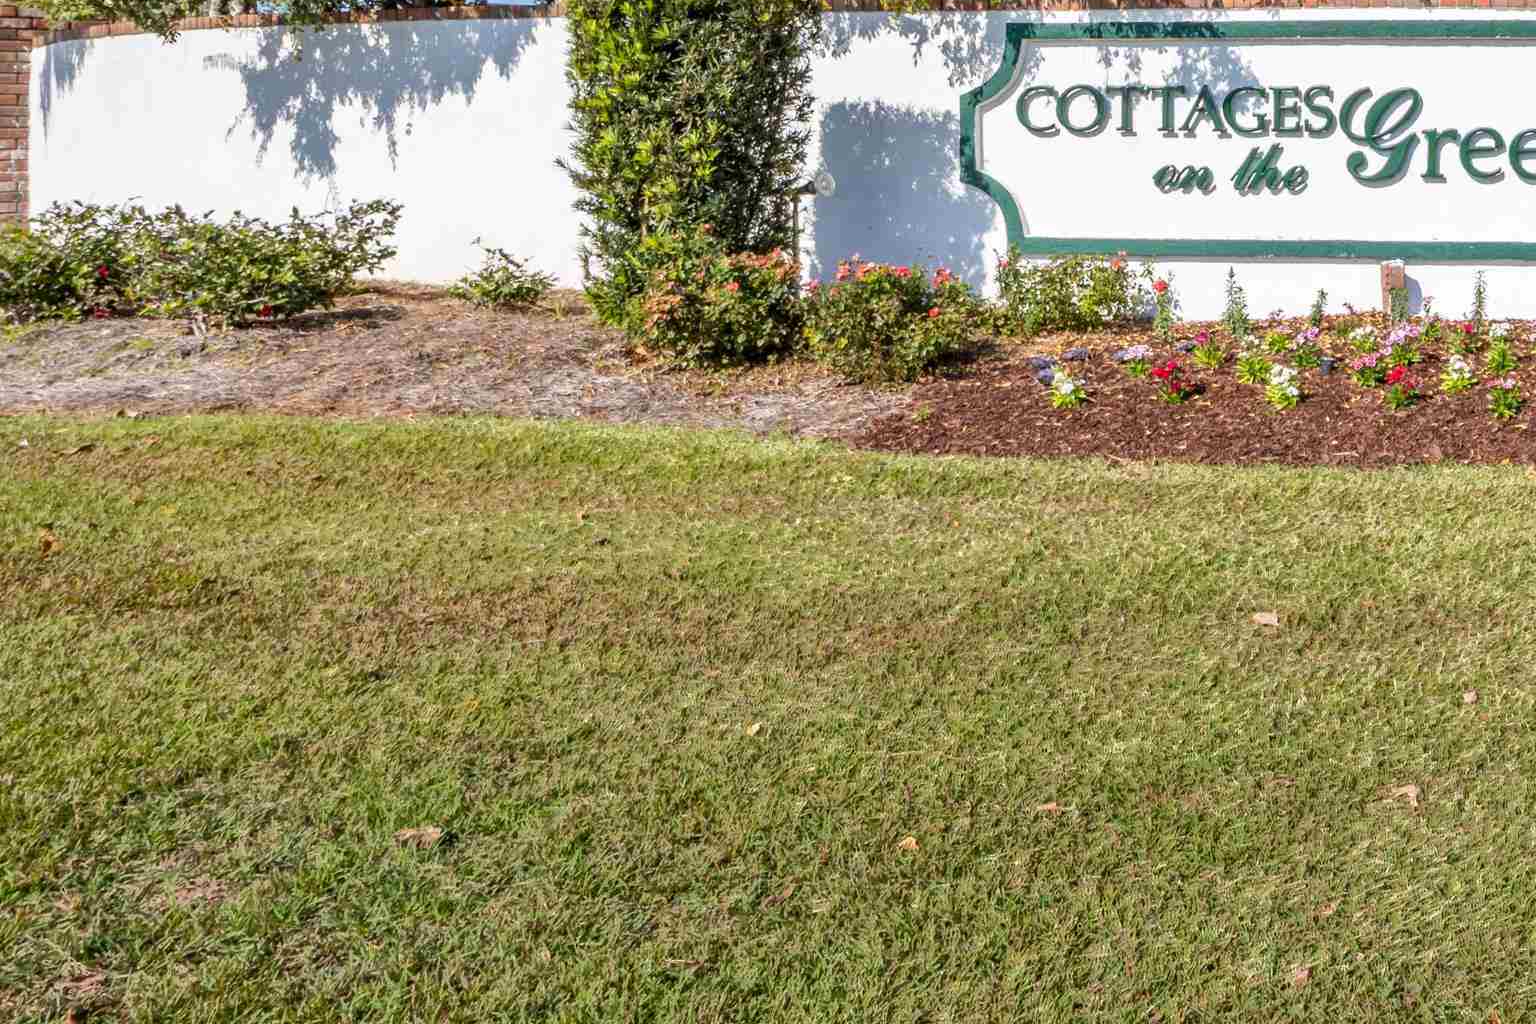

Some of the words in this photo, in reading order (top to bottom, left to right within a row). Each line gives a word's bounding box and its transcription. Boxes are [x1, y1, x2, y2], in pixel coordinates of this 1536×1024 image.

[1016, 85, 1337, 138] COTTAGES
[1152, 164, 1216, 196] on
[1231, 143, 1310, 196] the
